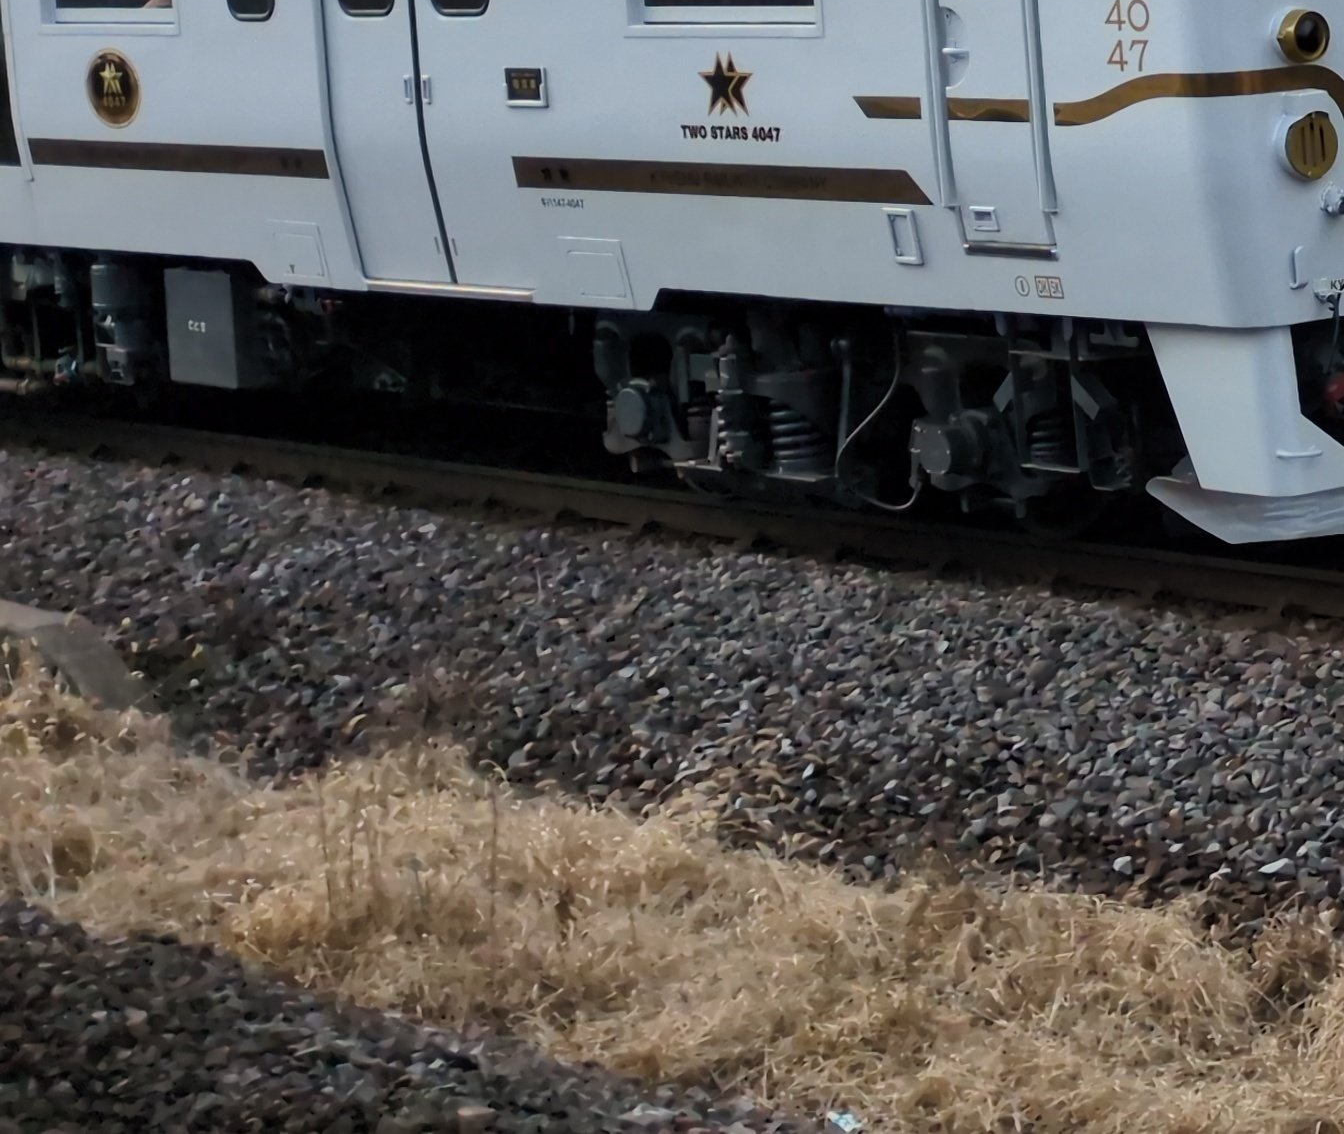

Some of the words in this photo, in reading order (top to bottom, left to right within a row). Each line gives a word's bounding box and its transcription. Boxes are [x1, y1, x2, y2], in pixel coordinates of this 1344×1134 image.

[1106, 39, 1149, 72] 47
[680, 124, 708, 139] TWO
[711, 125, 749, 141] STARS
[751, 127, 781, 142] 4047
